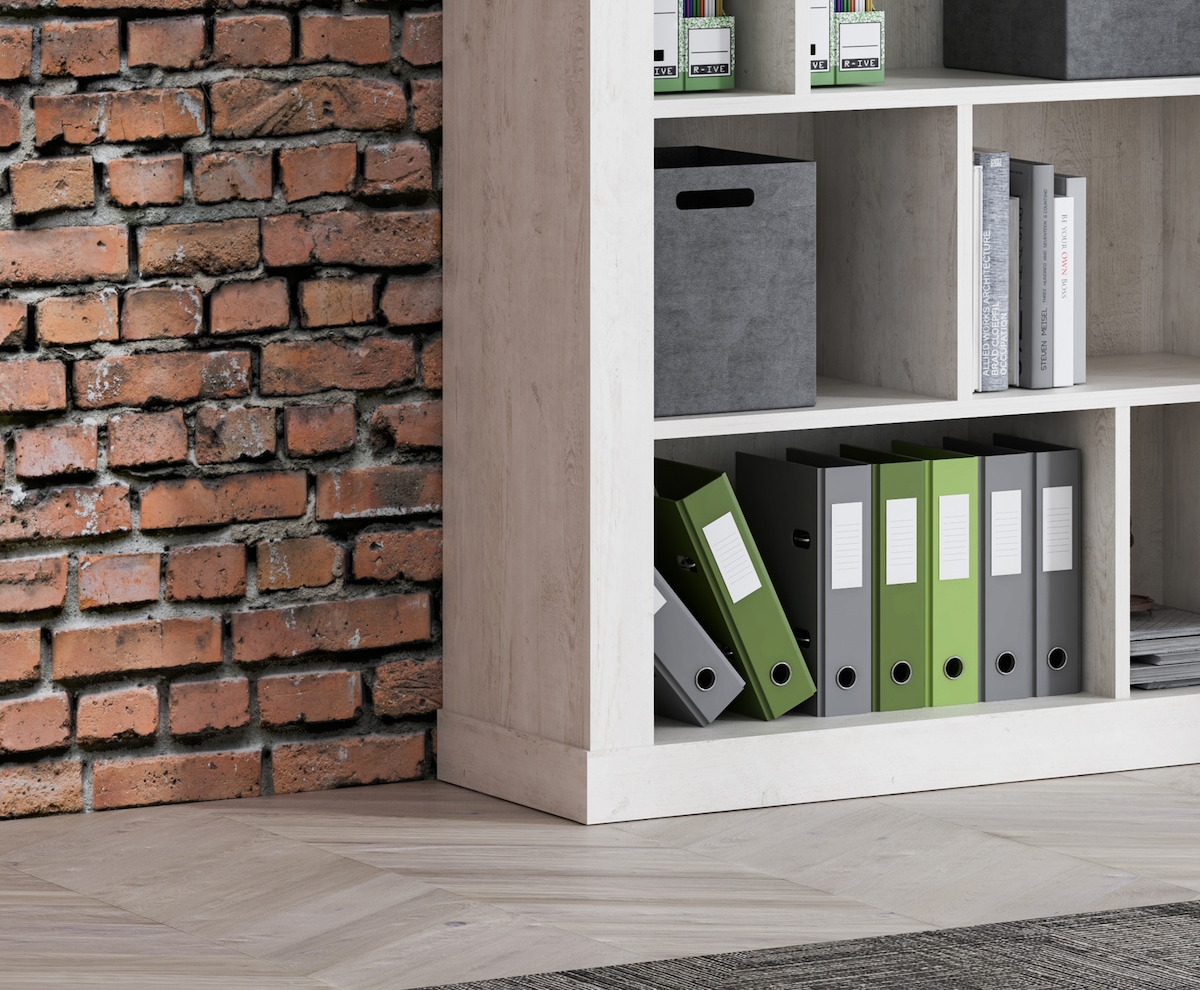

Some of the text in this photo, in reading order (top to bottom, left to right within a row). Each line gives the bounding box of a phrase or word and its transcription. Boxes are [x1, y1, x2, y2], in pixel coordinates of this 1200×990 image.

[844, 59, 876, 68] R-IVE
[654, 67, 674, 76] IVE
[693, 65, 727, 74] R-IVE
[1061, 214, 1068, 223] BE
[982, 230, 991, 376] ALLIED WORKS ARCHITECTURE
[991, 301, 999, 376] BRAD CLOEPFIL
[1000, 312, 1008, 376] OCCUPATION
